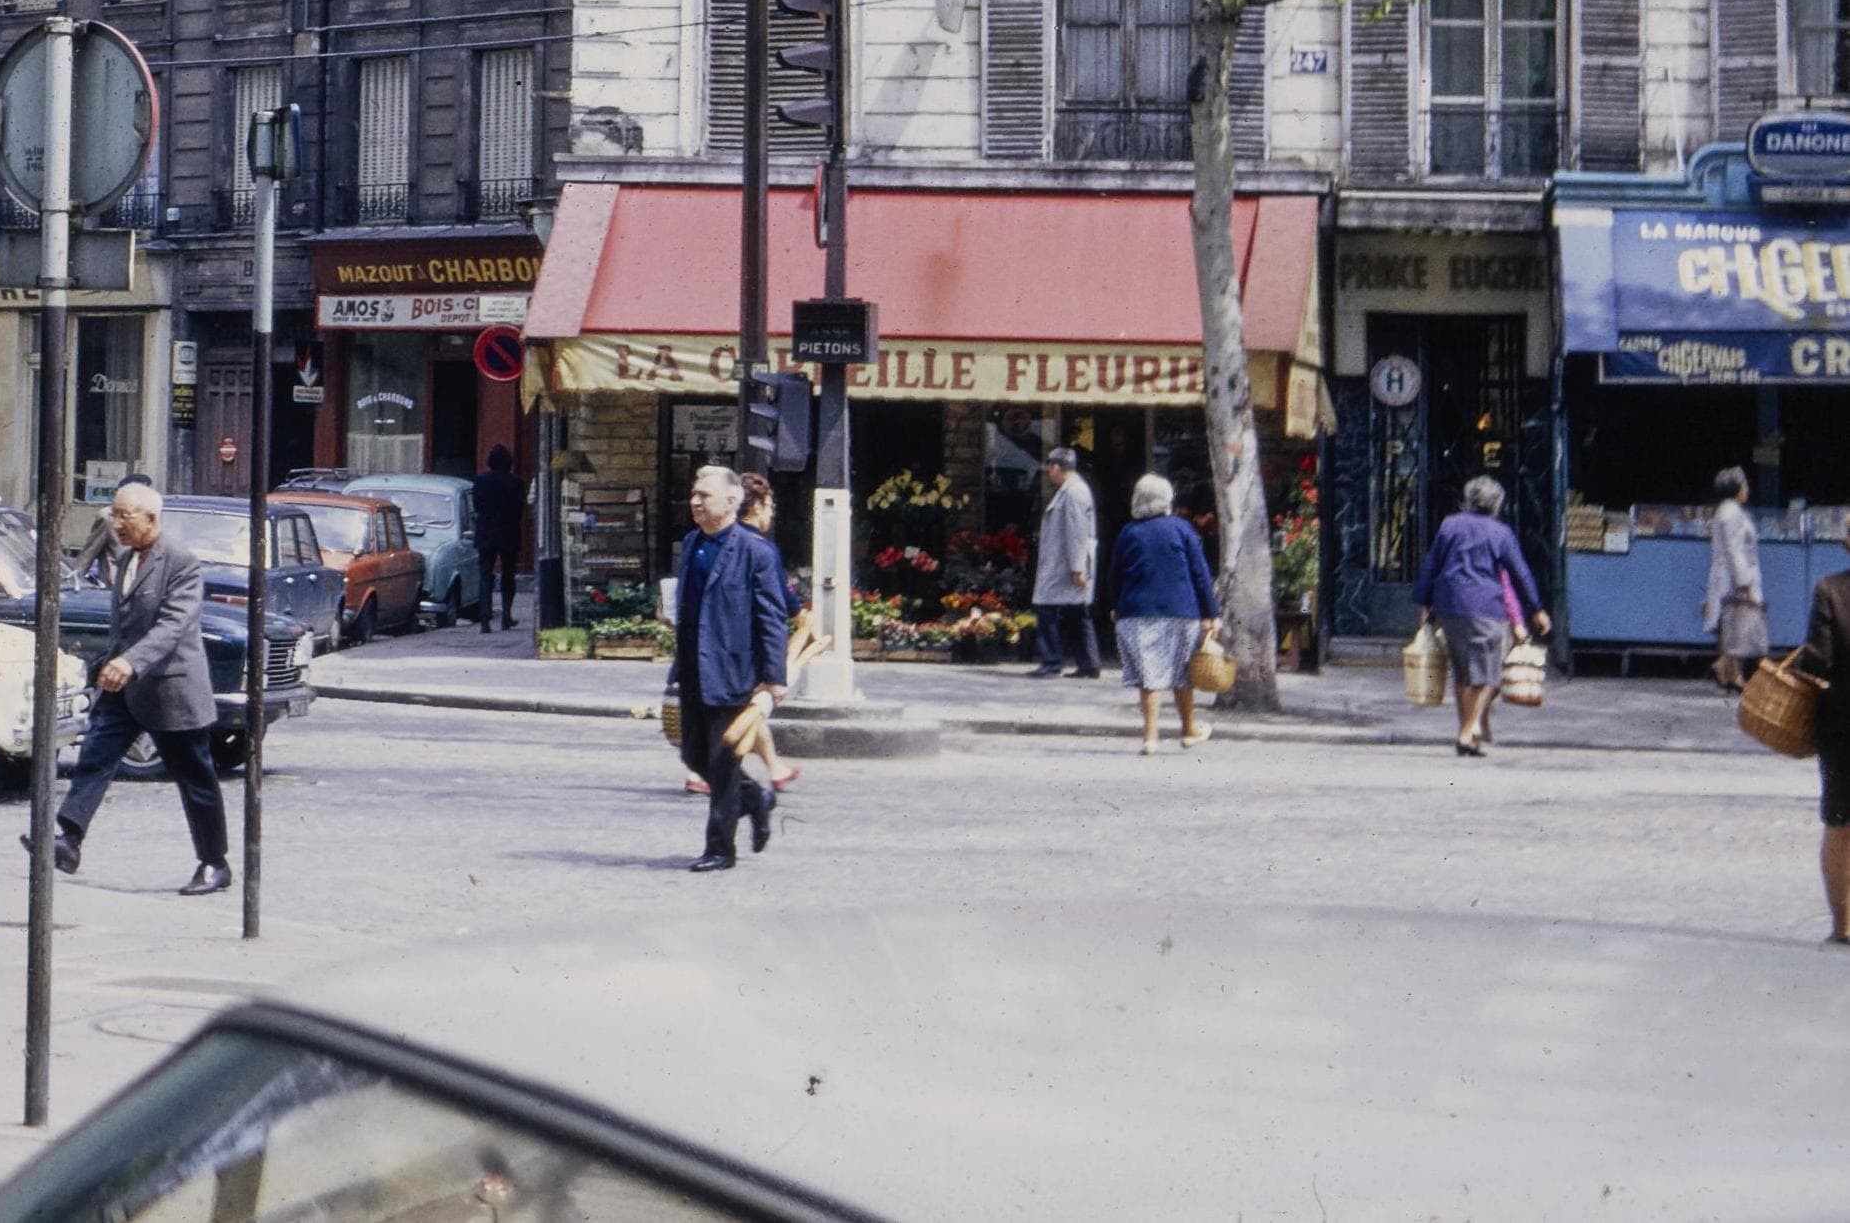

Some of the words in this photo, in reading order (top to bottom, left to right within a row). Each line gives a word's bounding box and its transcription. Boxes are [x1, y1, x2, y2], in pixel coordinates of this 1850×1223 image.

[1640, 222, 1668, 240] LA
[337, 264, 414, 283] MAZOUT
[333, 300, 380, 316] AMOS
[411, 298, 453, 320] BOIS
[798, 342, 862, 355] PIETONS
[616, 344, 684, 381] LA
